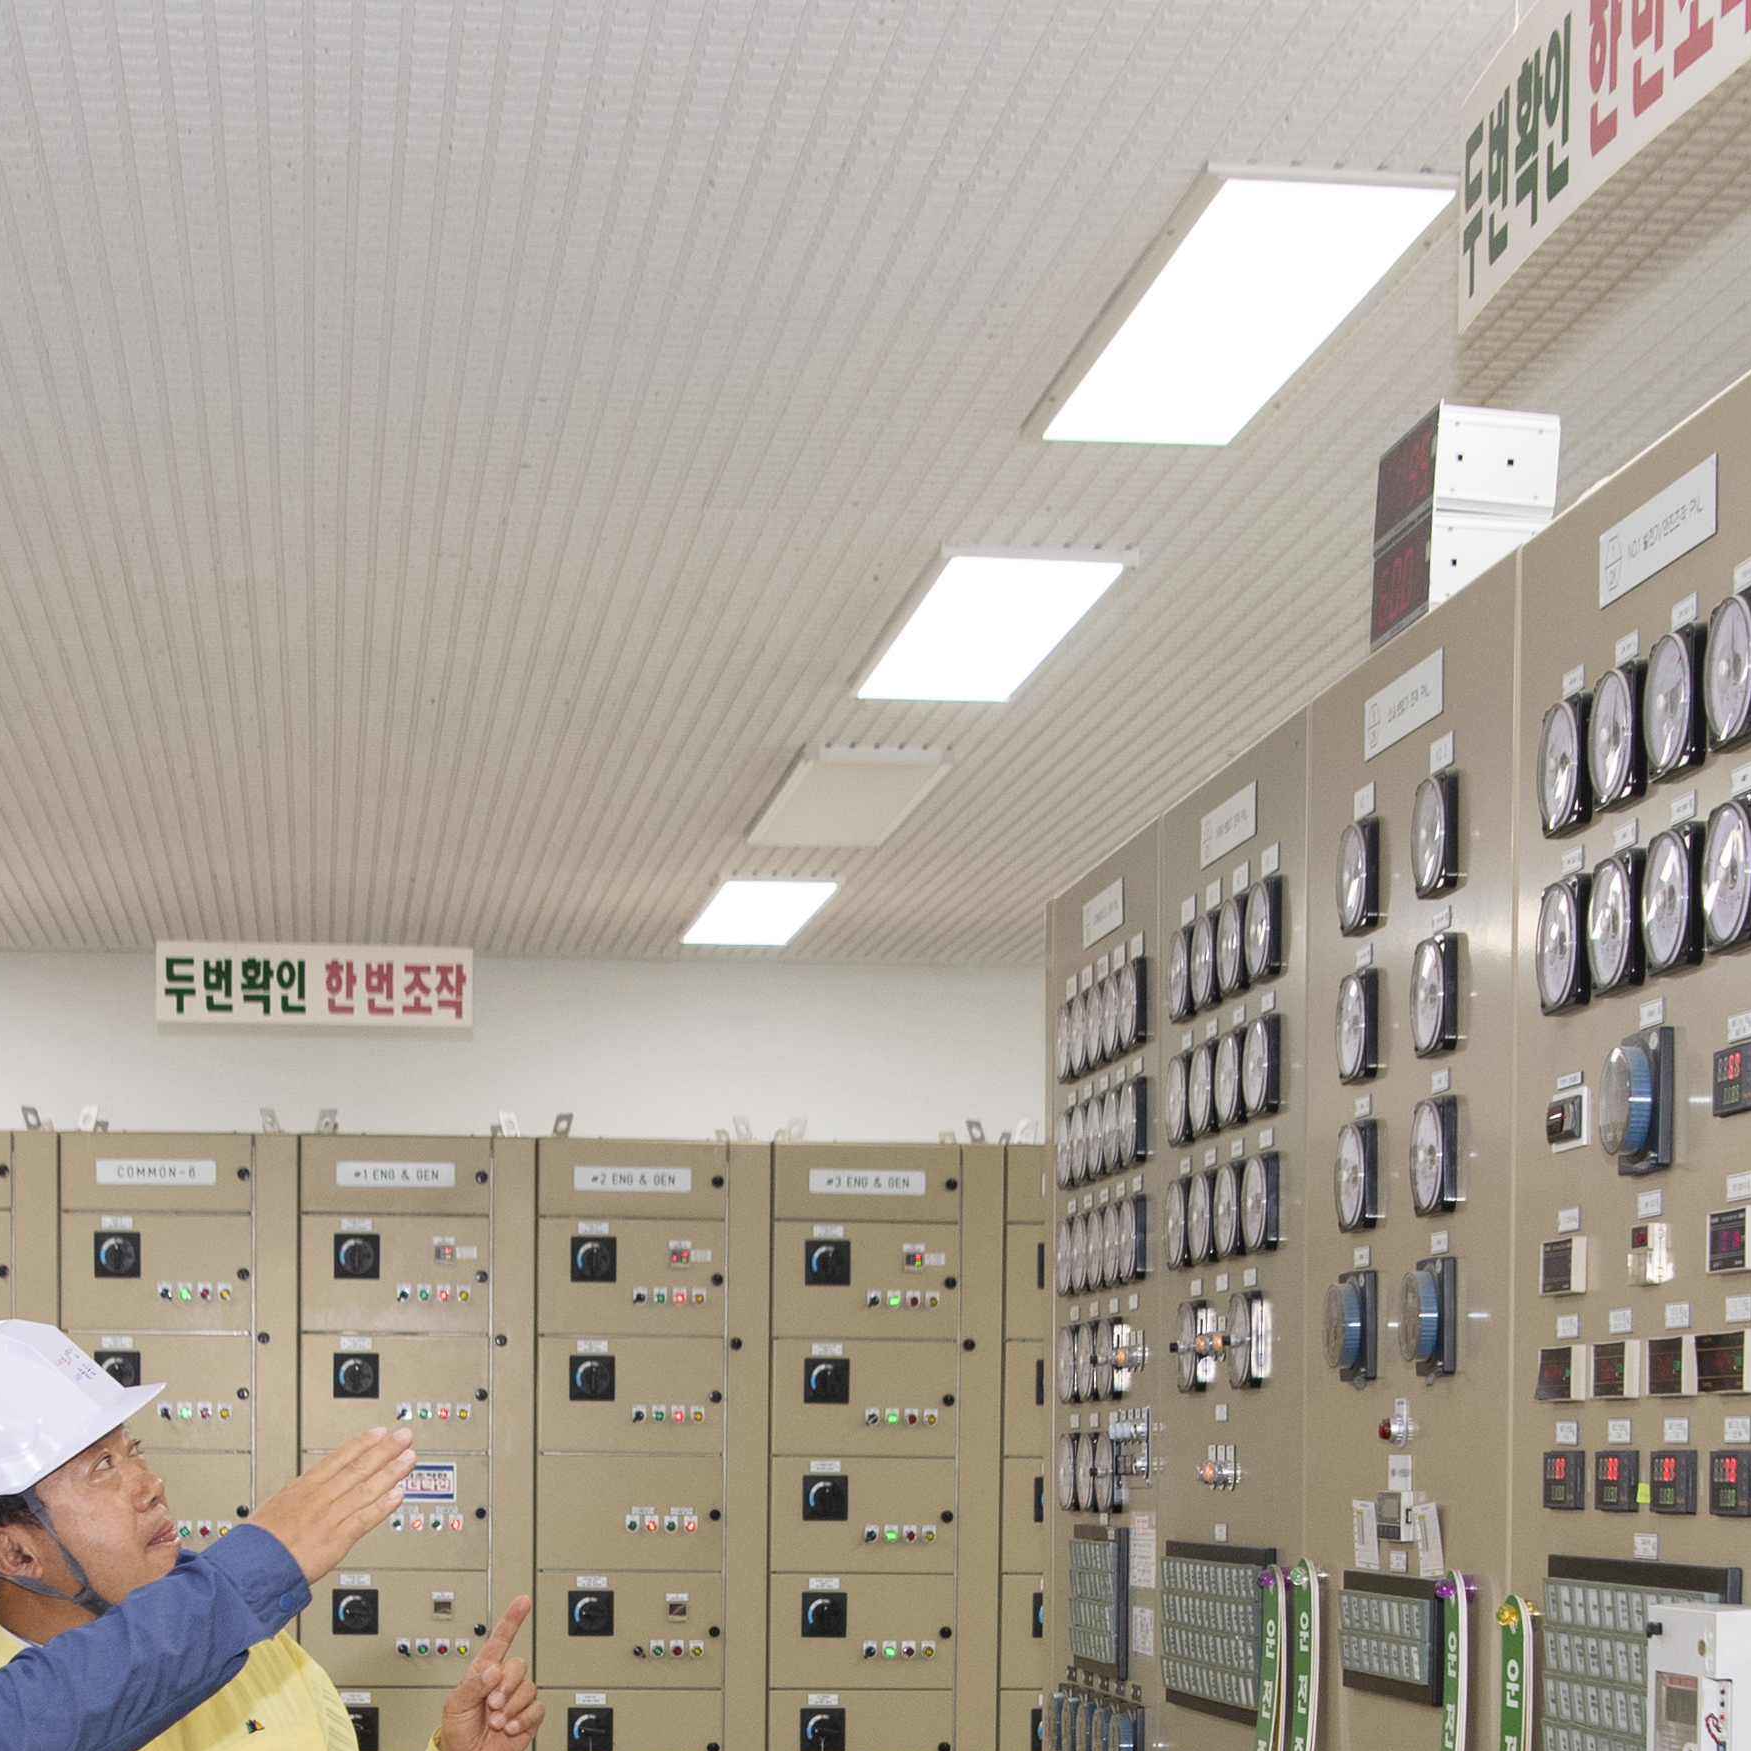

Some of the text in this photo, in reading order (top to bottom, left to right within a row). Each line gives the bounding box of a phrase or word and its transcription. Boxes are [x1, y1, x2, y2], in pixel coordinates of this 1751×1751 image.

[1462, 10, 1573, 300] 두번확인
[163, 955, 468, 1022] 두번확인 한번조작
[115, 1164, 198, 1179] COMMON-6
[371, 1167, 396, 1183] ENG
[400, 1168, 412, 1183] &
[415, 1168, 440, 1183] GEN
[610, 1171, 635, 1187] ENG
[638, 1172, 650, 1187] &
[652, 1172, 678, 1187] GEN
[845, 1175, 869, 1190] ENG
[872, 1175, 884, 1190] &
[886, 1175, 911, 1190] GEN
